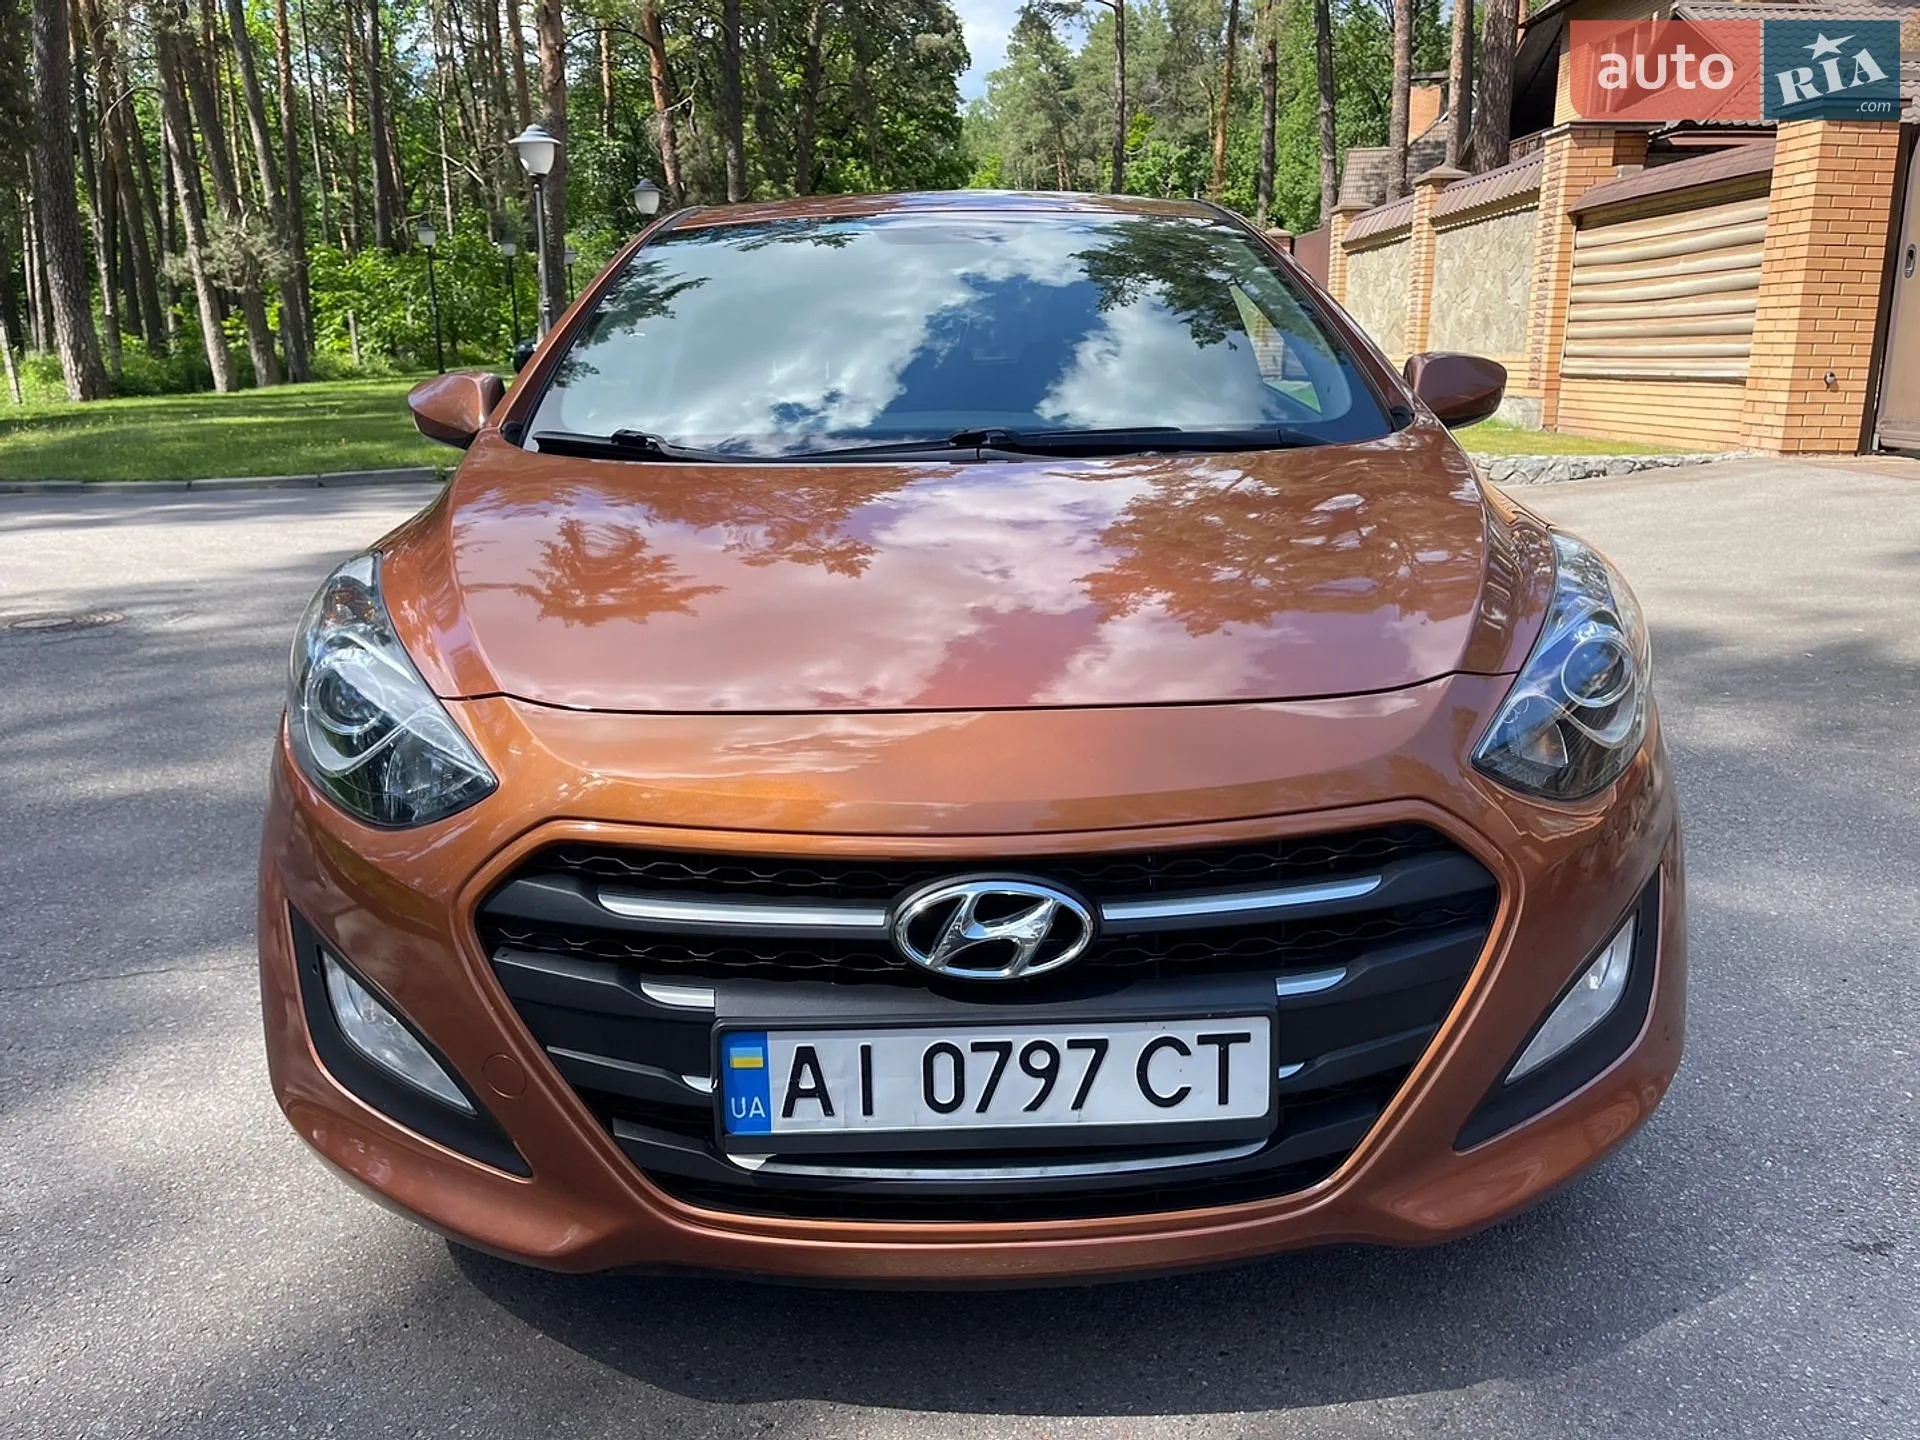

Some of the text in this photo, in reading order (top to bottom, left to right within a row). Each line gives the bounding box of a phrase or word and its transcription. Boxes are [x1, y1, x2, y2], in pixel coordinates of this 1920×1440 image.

[781, 1032, 1251, 1118] AI 0797 CT
[731, 1096, 766, 1119] UA
